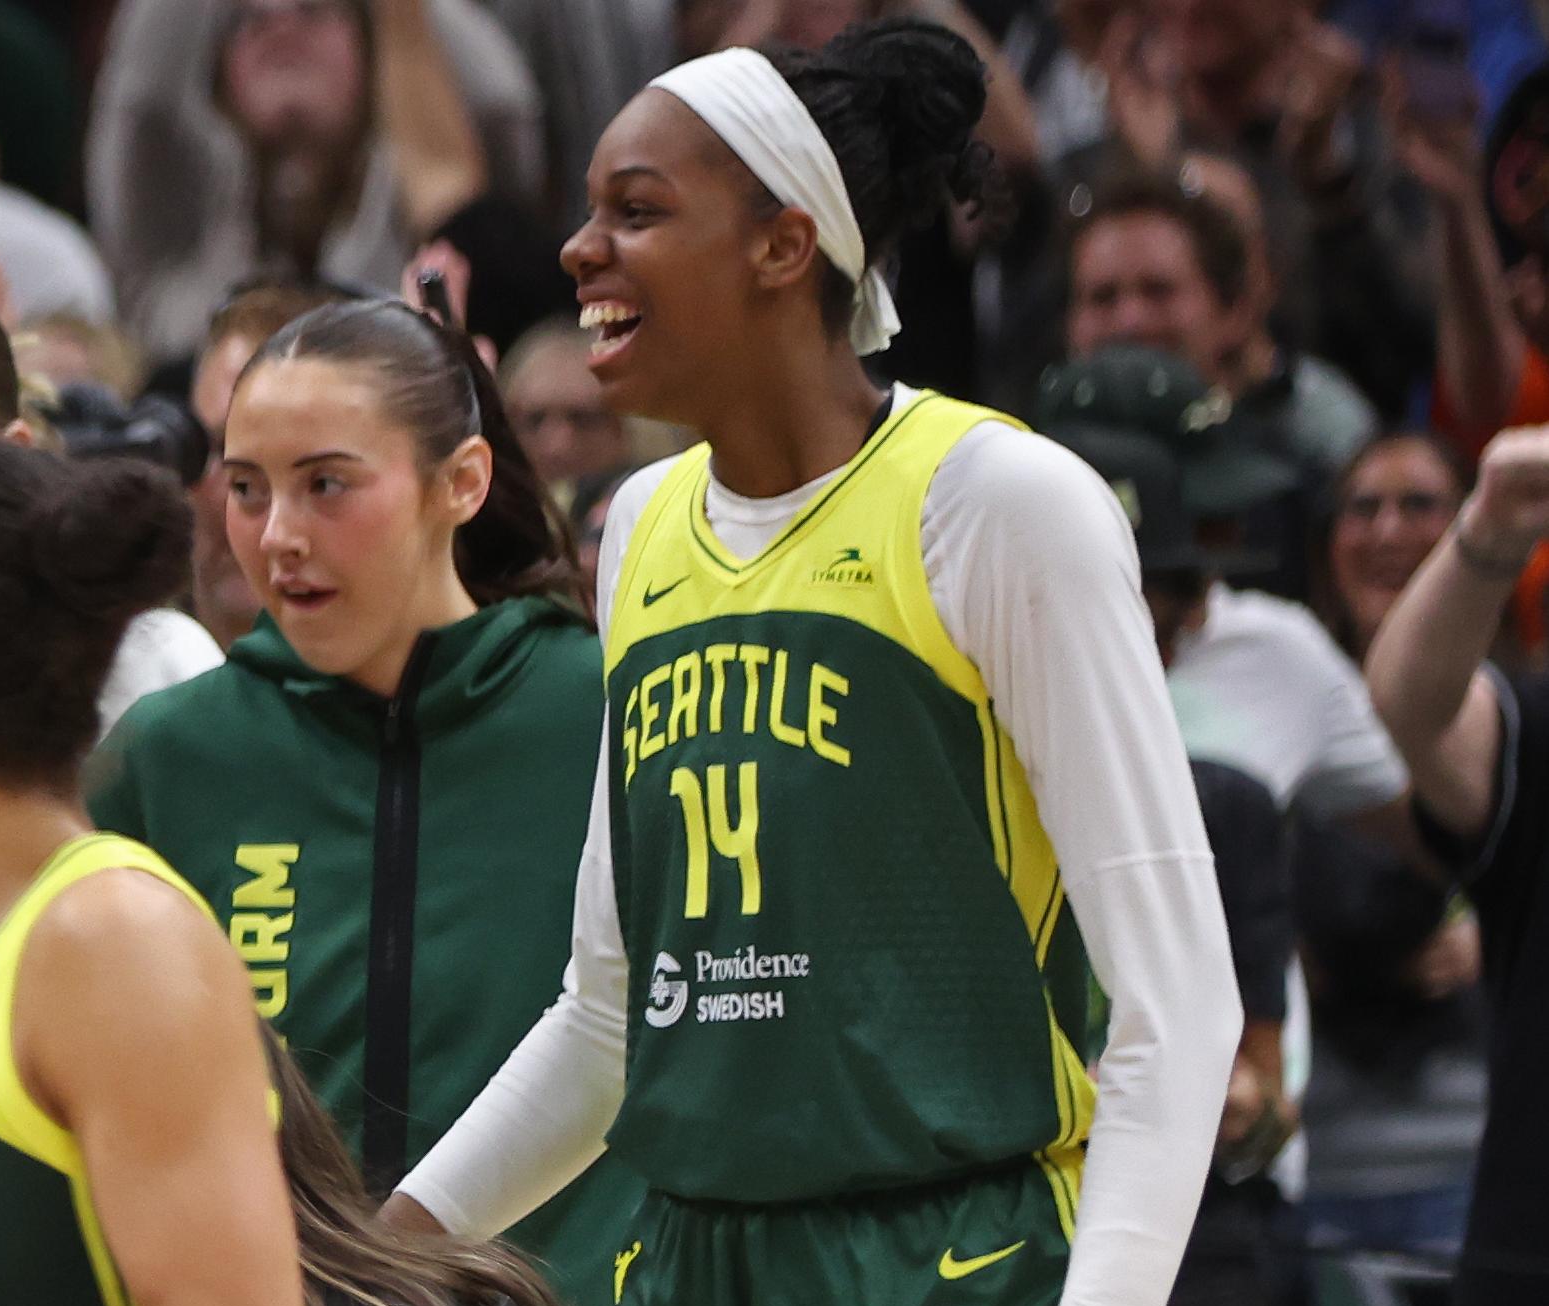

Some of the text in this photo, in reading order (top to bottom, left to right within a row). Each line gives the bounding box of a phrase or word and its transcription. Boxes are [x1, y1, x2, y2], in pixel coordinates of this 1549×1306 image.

[623, 642, 852, 794] SEATTLE
[669, 761, 762, 919] 14
[229, 843, 300, 1052] ORM
[694, 944, 810, 982] Providence
[696, 990, 785, 1023] SWEDISH
